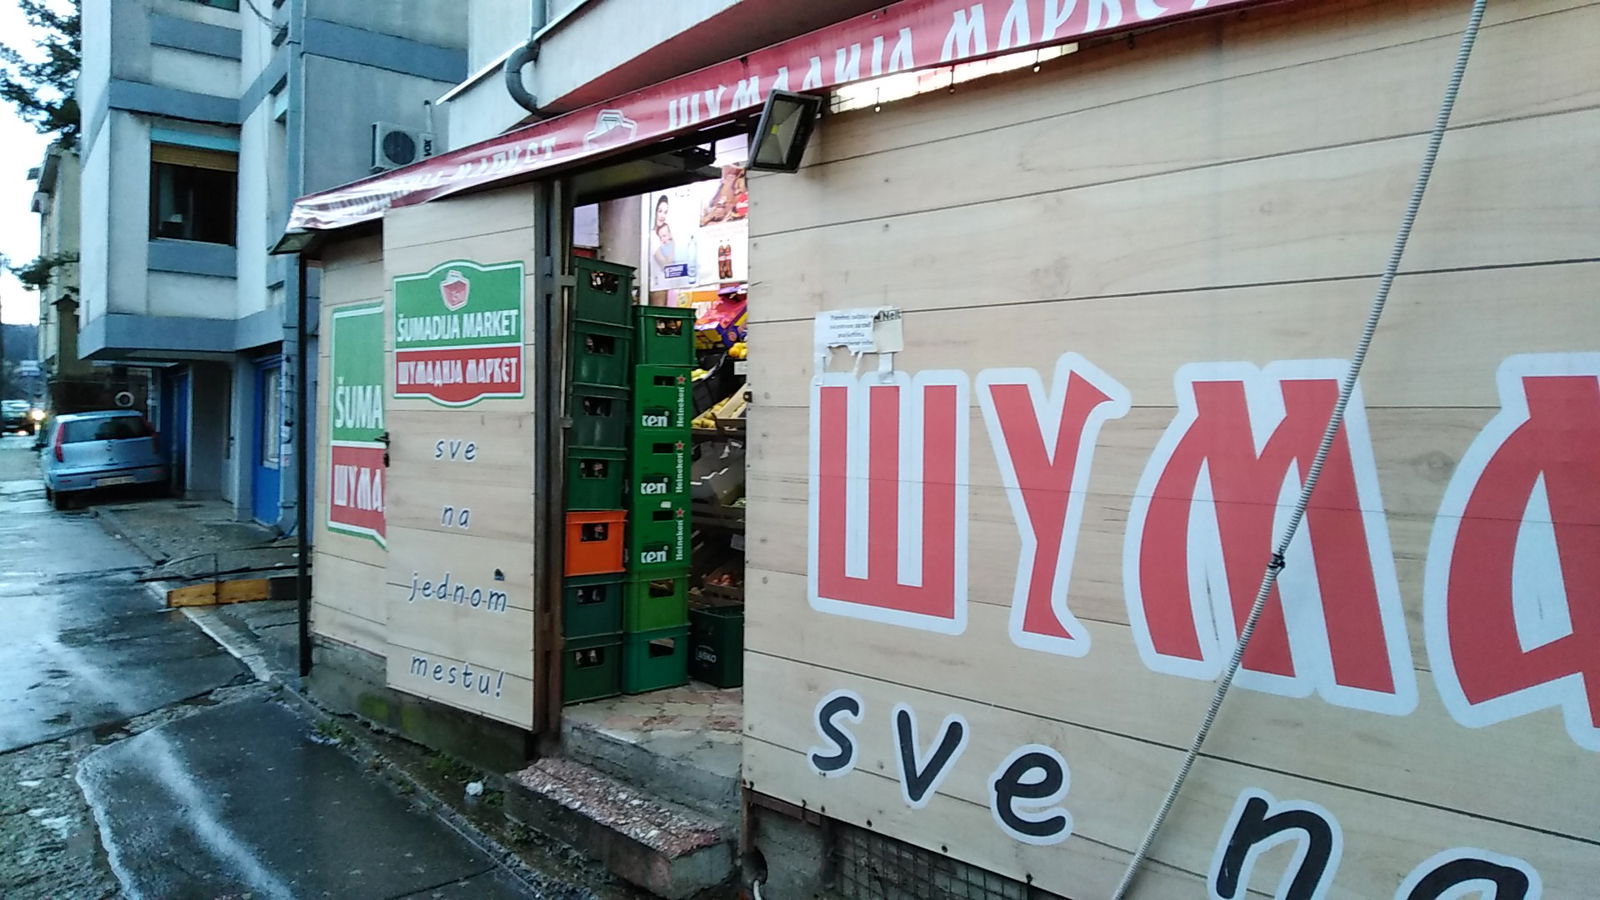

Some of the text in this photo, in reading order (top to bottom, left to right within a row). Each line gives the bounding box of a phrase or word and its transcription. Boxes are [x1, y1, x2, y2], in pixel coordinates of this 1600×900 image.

[938, 0, 1203, 63] МАРК
[396, 309, 519, 342] ŠUMADIJA MARKET
[465, 357, 518, 384] МАРКЕТ
[434, 439, 478, 462] sve
[441, 504, 470, 529] na
[408, 572, 508, 612] jednom
[410, 655, 505, 698] mestu!
[810, 692, 1069, 840] sve
